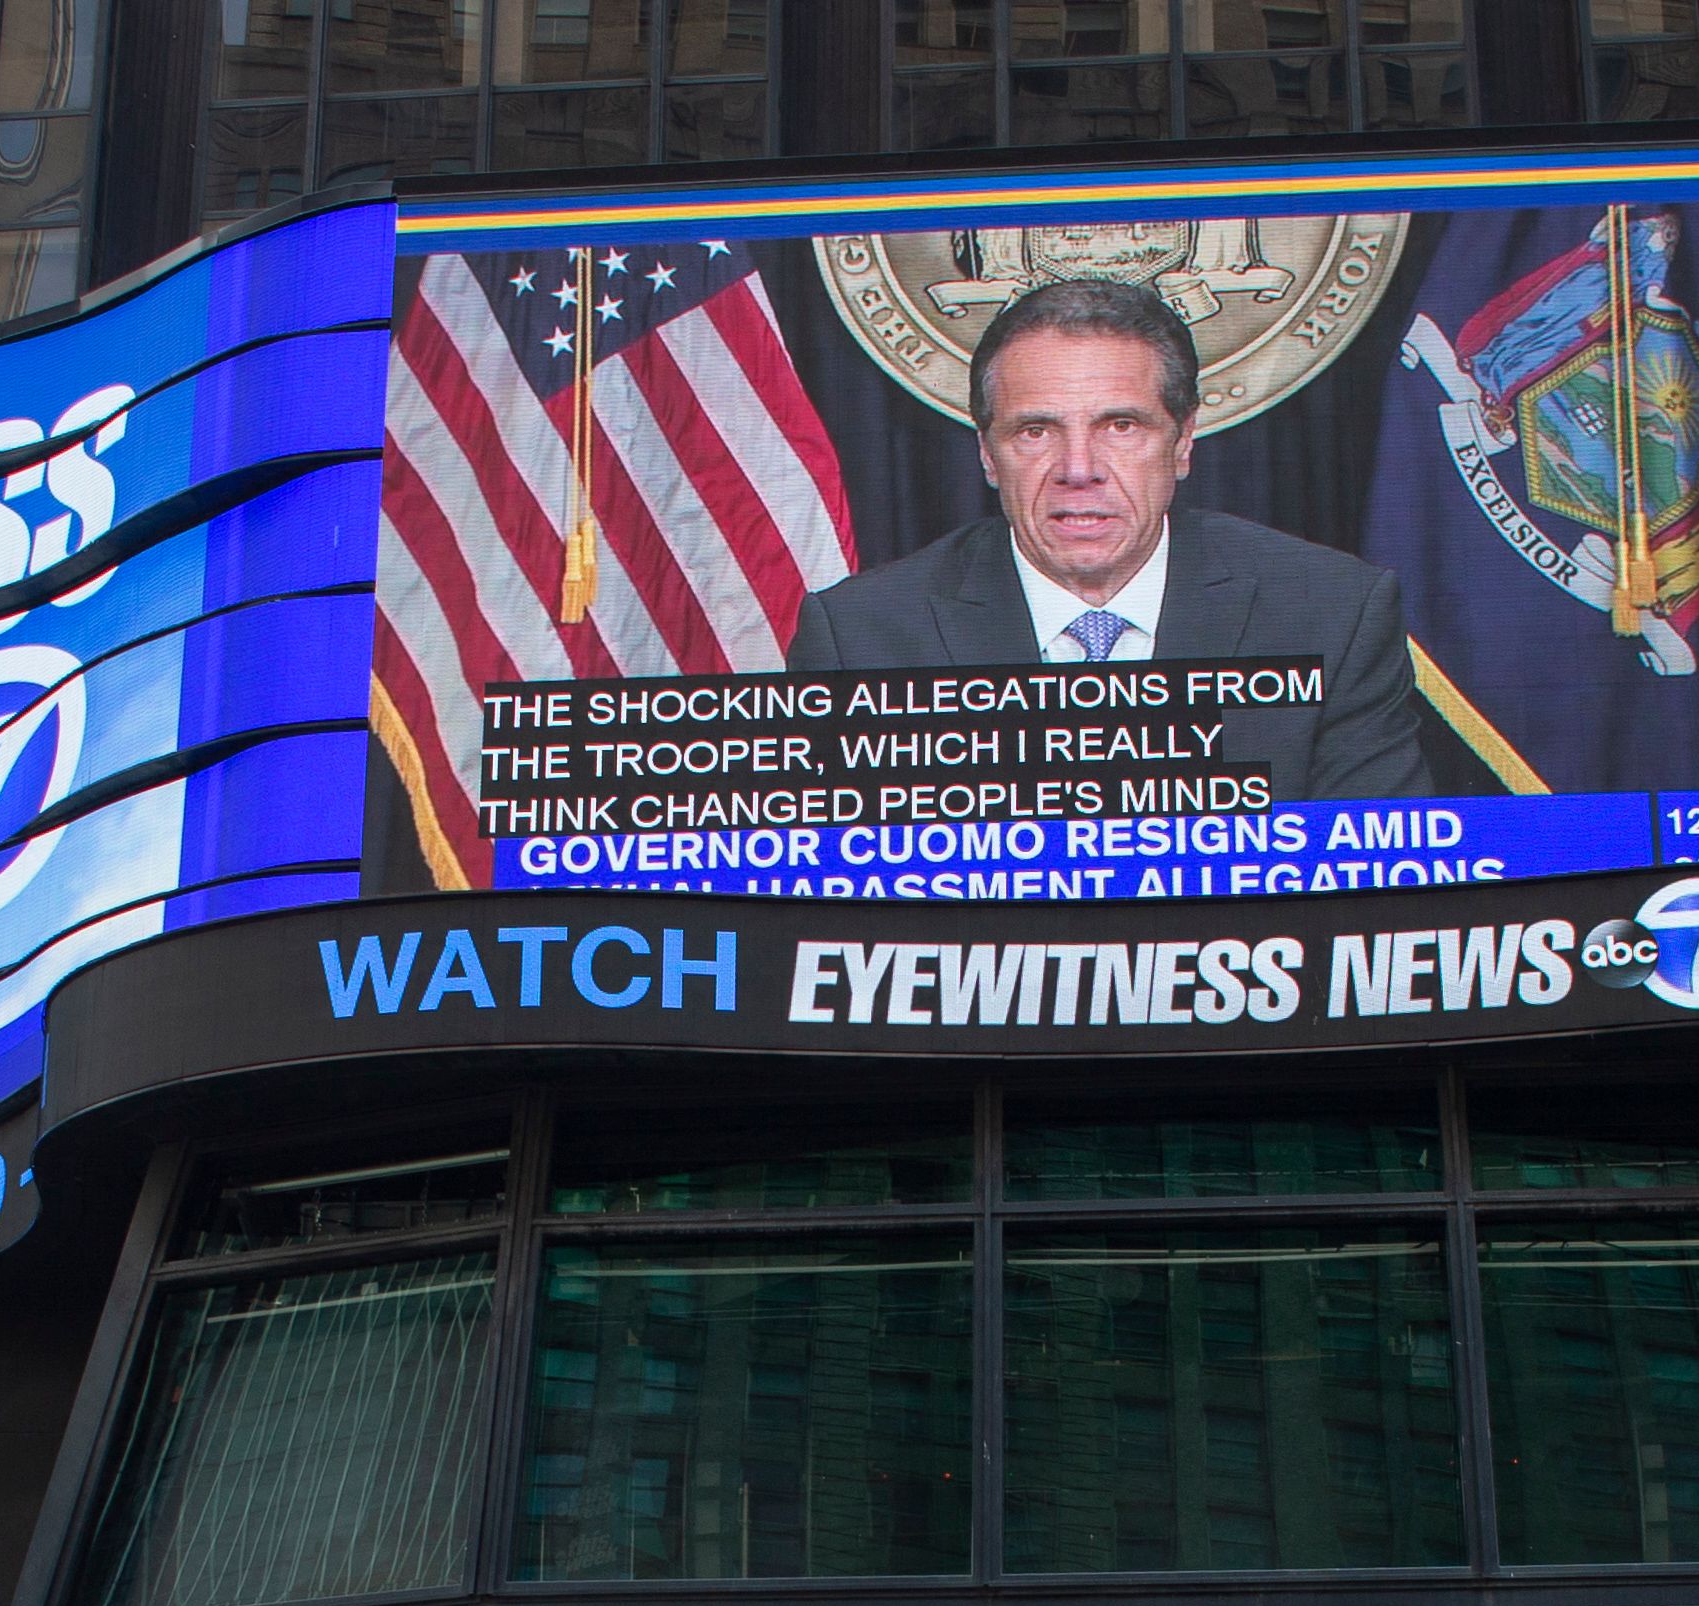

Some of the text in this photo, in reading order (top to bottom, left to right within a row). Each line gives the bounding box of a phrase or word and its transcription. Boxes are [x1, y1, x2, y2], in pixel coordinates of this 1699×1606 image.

[1291, 232, 1383, 347] YORK
[1454, 440, 1579, 587] EXCELSIOR
[484, 669, 1324, 729] THE SHOCKING ALLEGATIONS FROM
[481, 723, 1223, 781] THE TROOPER, WHICH I REALLY
[480, 776, 1271, 833] THINK CHANGED PEOPLE'S MINDS
[521, 810, 1463, 875] GOVERNOR CUOMO RESIGNS AMID
[318, 926, 737, 1019] WATCH
[788, 937, 1303, 1025] EYEWITNESS
[1327, 919, 1575, 1018] NEWS
[1581, 932, 1658, 968] abc
